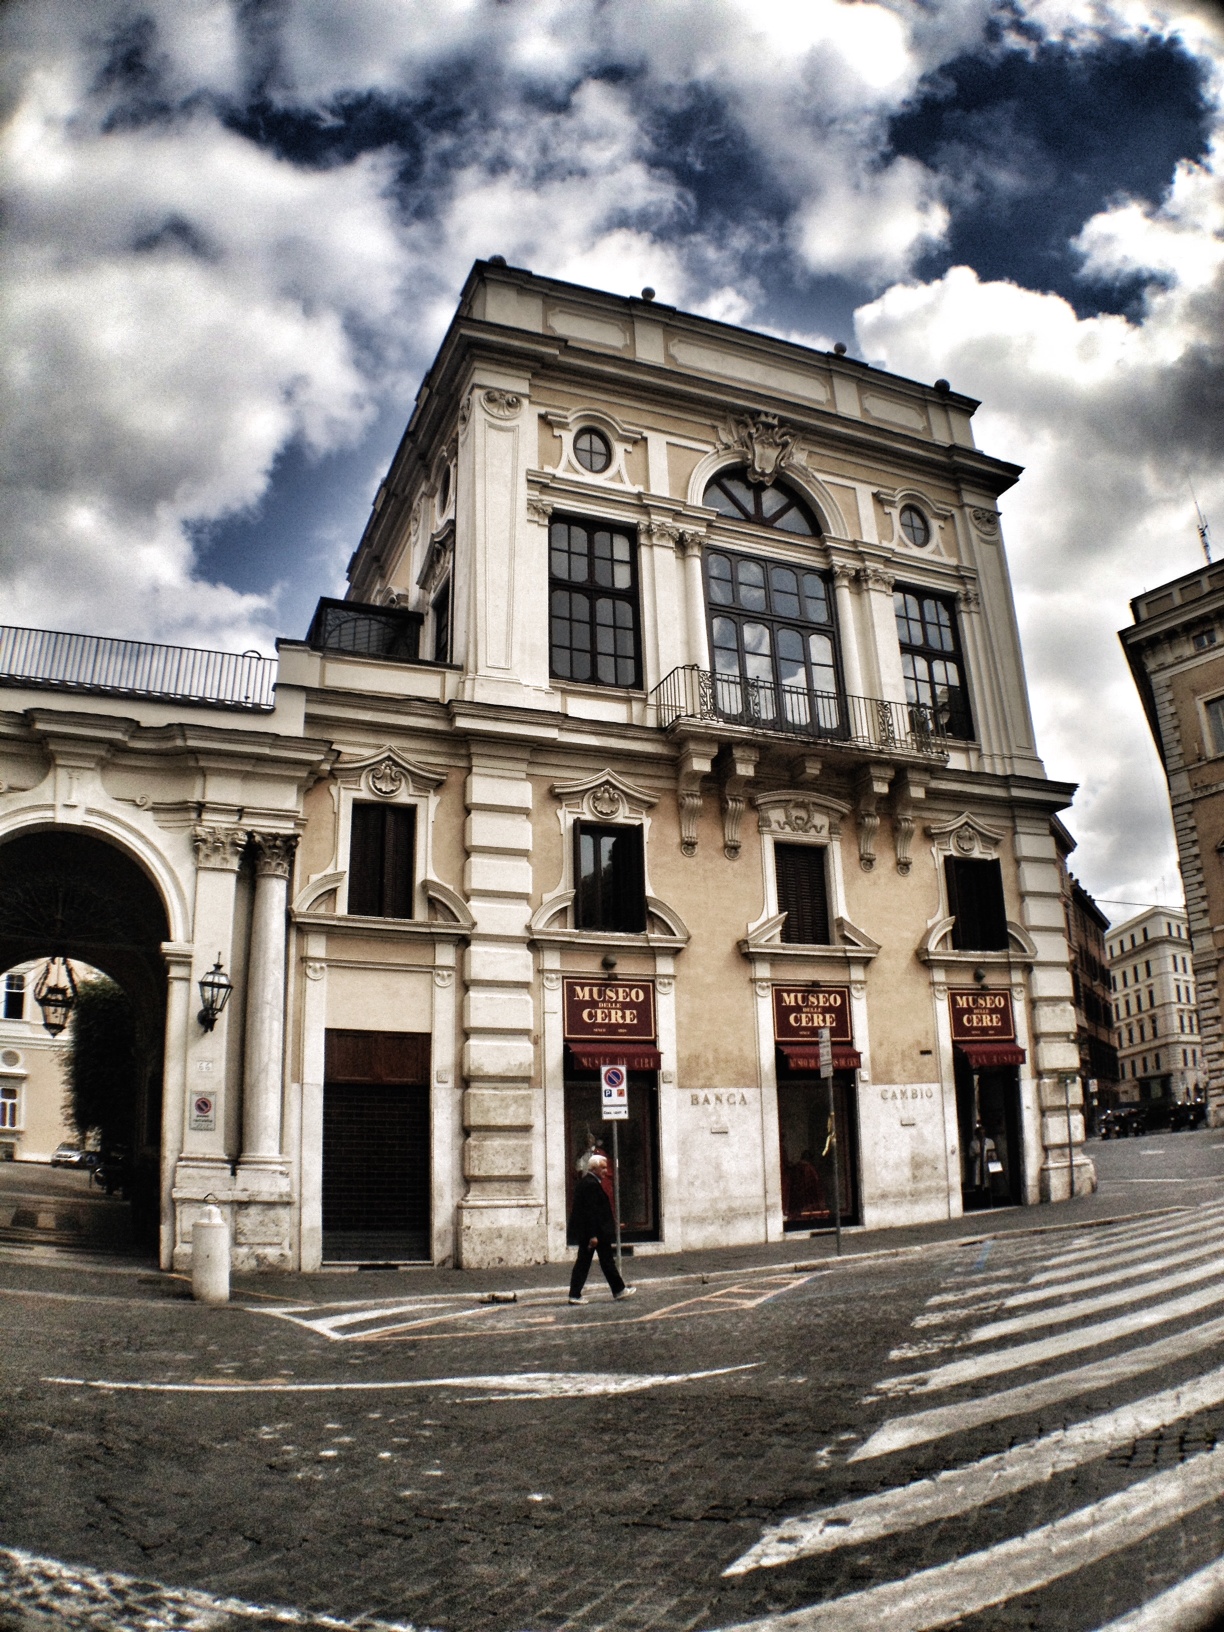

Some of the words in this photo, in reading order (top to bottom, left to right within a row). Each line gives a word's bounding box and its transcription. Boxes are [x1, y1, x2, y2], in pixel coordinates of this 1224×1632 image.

[573, 985, 645, 1002] MUSEO
[781, 992, 842, 1007] MUSEO
[955, 995, 1005, 1009] MUSEO
[581, 1008, 638, 1024] CERE
[789, 1012, 836, 1027] CERE
[962, 1013, 1002, 1027] CERE
[690, 1091, 748, 1106] BANCA
[880, 1088, 934, 1101] CAMBIO
